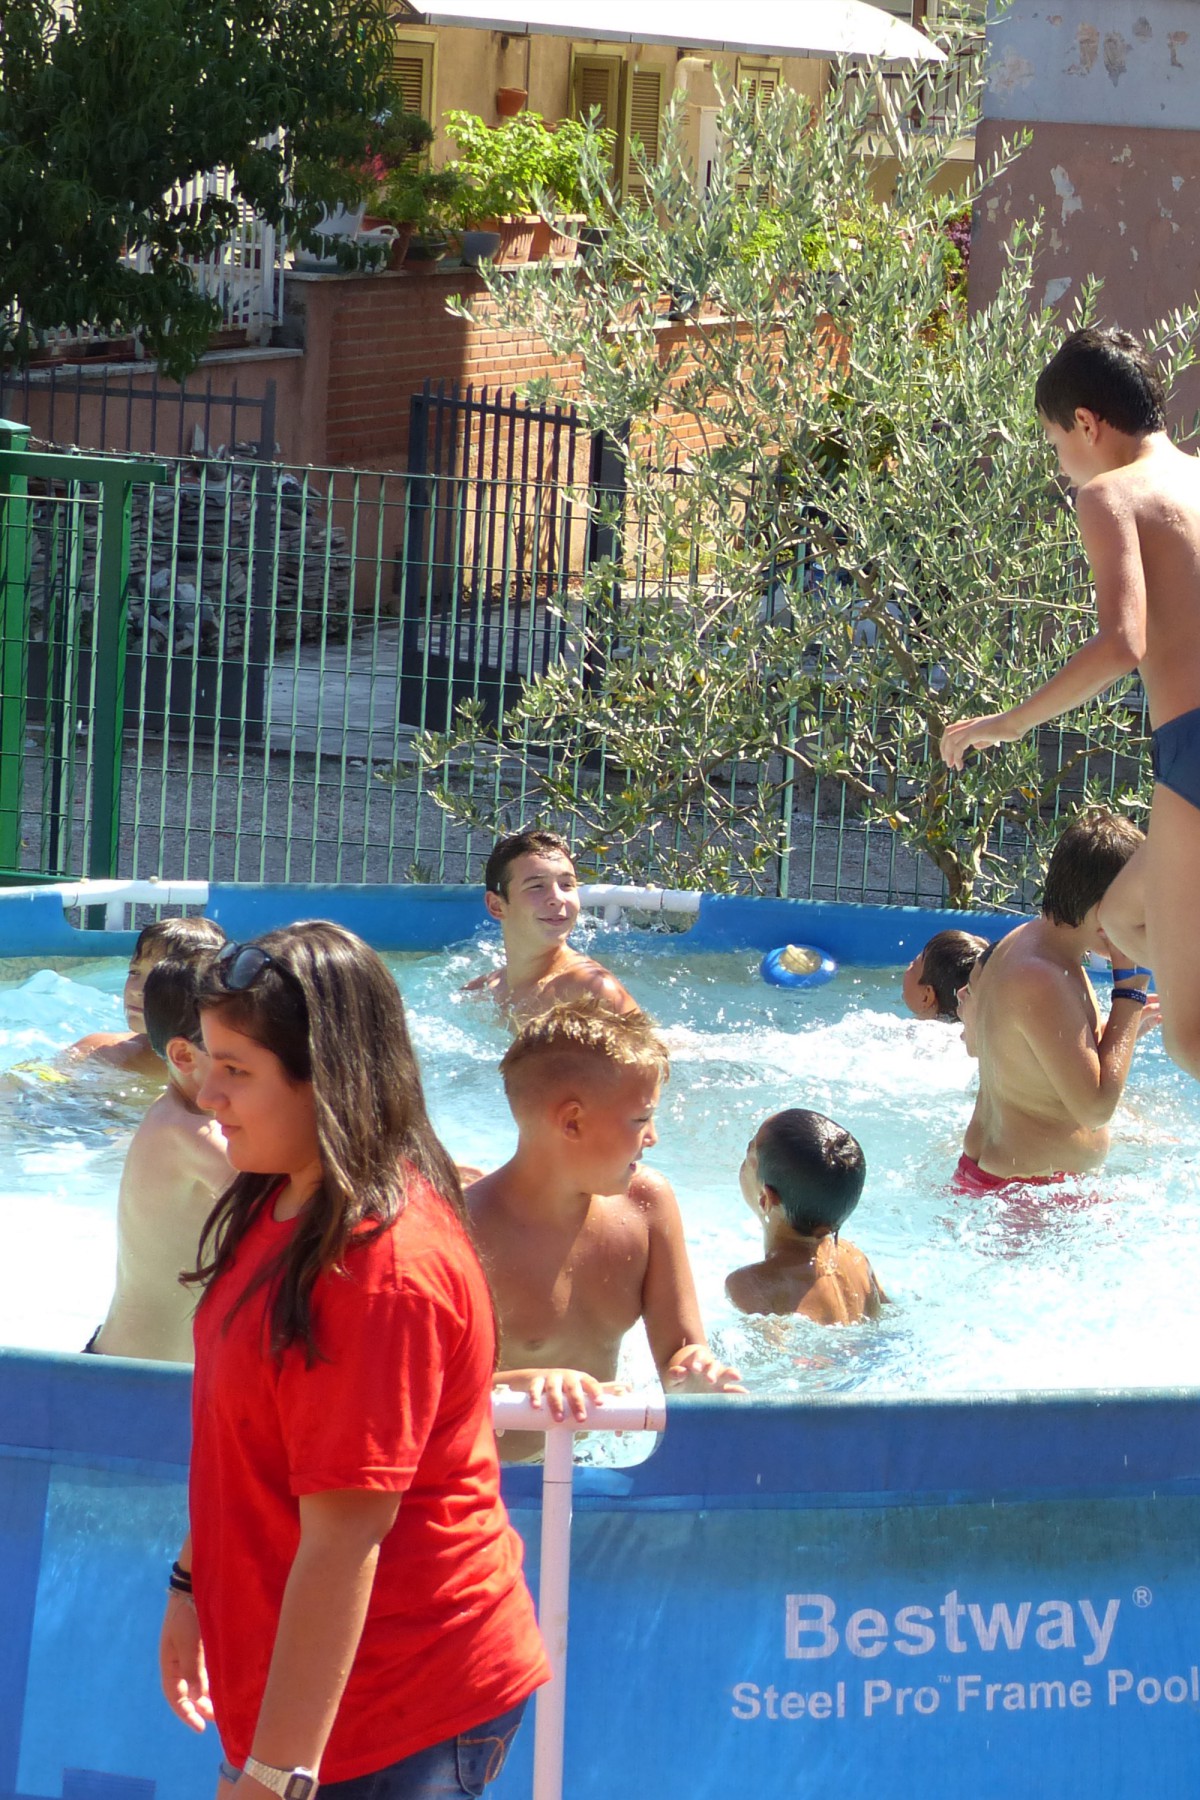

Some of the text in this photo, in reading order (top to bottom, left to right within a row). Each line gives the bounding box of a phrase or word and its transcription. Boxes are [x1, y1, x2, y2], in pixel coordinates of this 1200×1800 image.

[786, 1591, 1120, 1665] Bestway
[732, 1682, 845, 1719] Steel
[864, 1679, 940, 1716] Pro
[957, 1675, 1092, 1711] Frame
[1108, 1666, 1199, 1705] Pool
